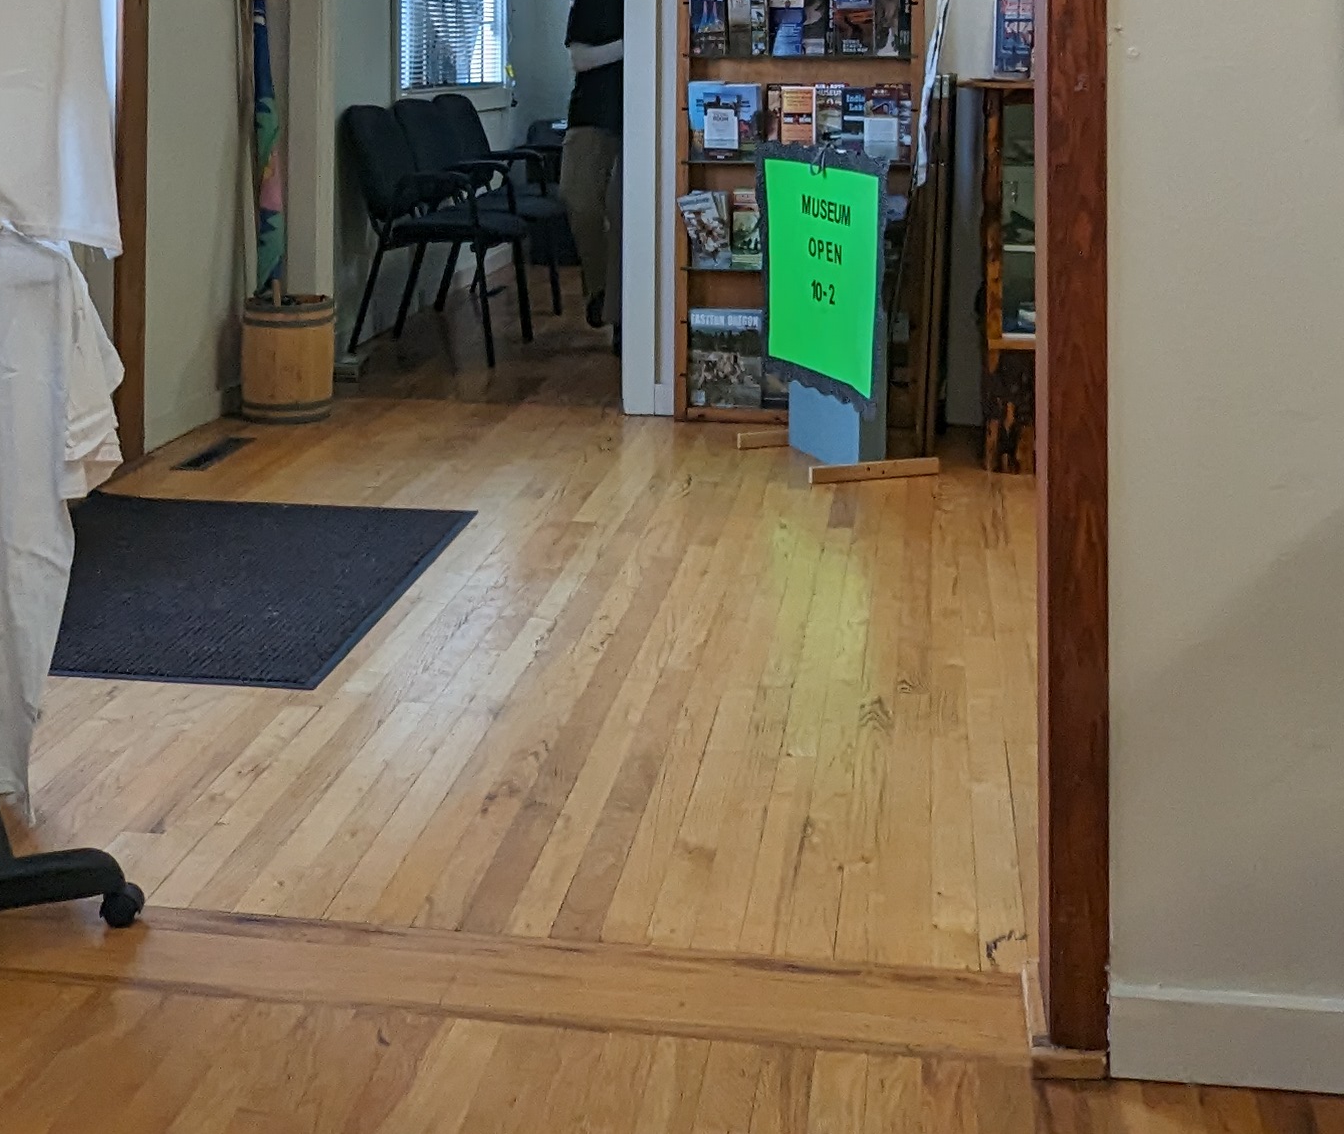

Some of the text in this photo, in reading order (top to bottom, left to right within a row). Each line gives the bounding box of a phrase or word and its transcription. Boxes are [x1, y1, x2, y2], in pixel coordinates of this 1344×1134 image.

[801, 193, 852, 227] MUSEUM
[808, 237, 843, 266] OPEN
[810, 279, 836, 306] 10-2
